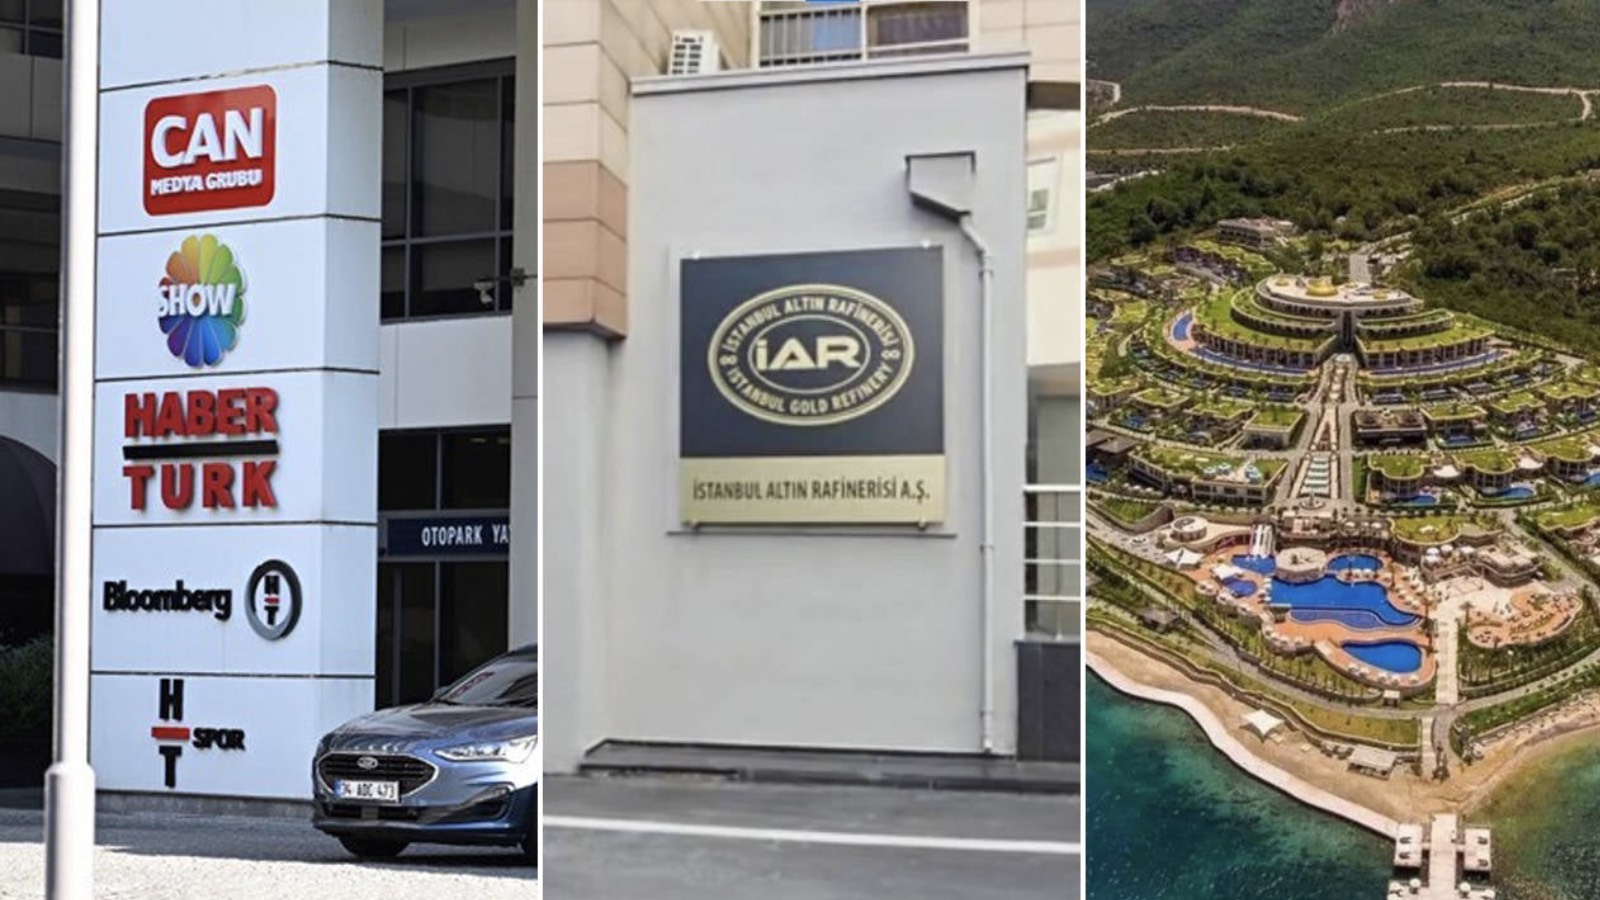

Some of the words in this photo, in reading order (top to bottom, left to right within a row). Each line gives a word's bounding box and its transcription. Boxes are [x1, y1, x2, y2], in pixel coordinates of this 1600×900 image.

[150, 107, 264, 169] CAN
[150, 174, 204, 196] MEDYA
[205, 168, 263, 191] GRUBU
[157, 282, 237, 318] SHOW
[783, 296, 825, 314] ALTIN
[756, 335, 862, 371] İAR
[789, 399, 829, 415] GOLD
[830, 361, 894, 410] REFINERY
[124, 386, 280, 438] HABER
[122, 460, 279, 511] TURK
[692, 477, 763, 500] İSTANBUL
[765, 479, 808, 499] ALTIN
[811, 475, 898, 499] RAFİNERİSİ
[900, 479, 931, 503] A.Ş.
[421, 525, 483, 547] OTOPARK
[103, 580, 233, 622] Bloomberg
[193, 728, 246, 750] SPOR
